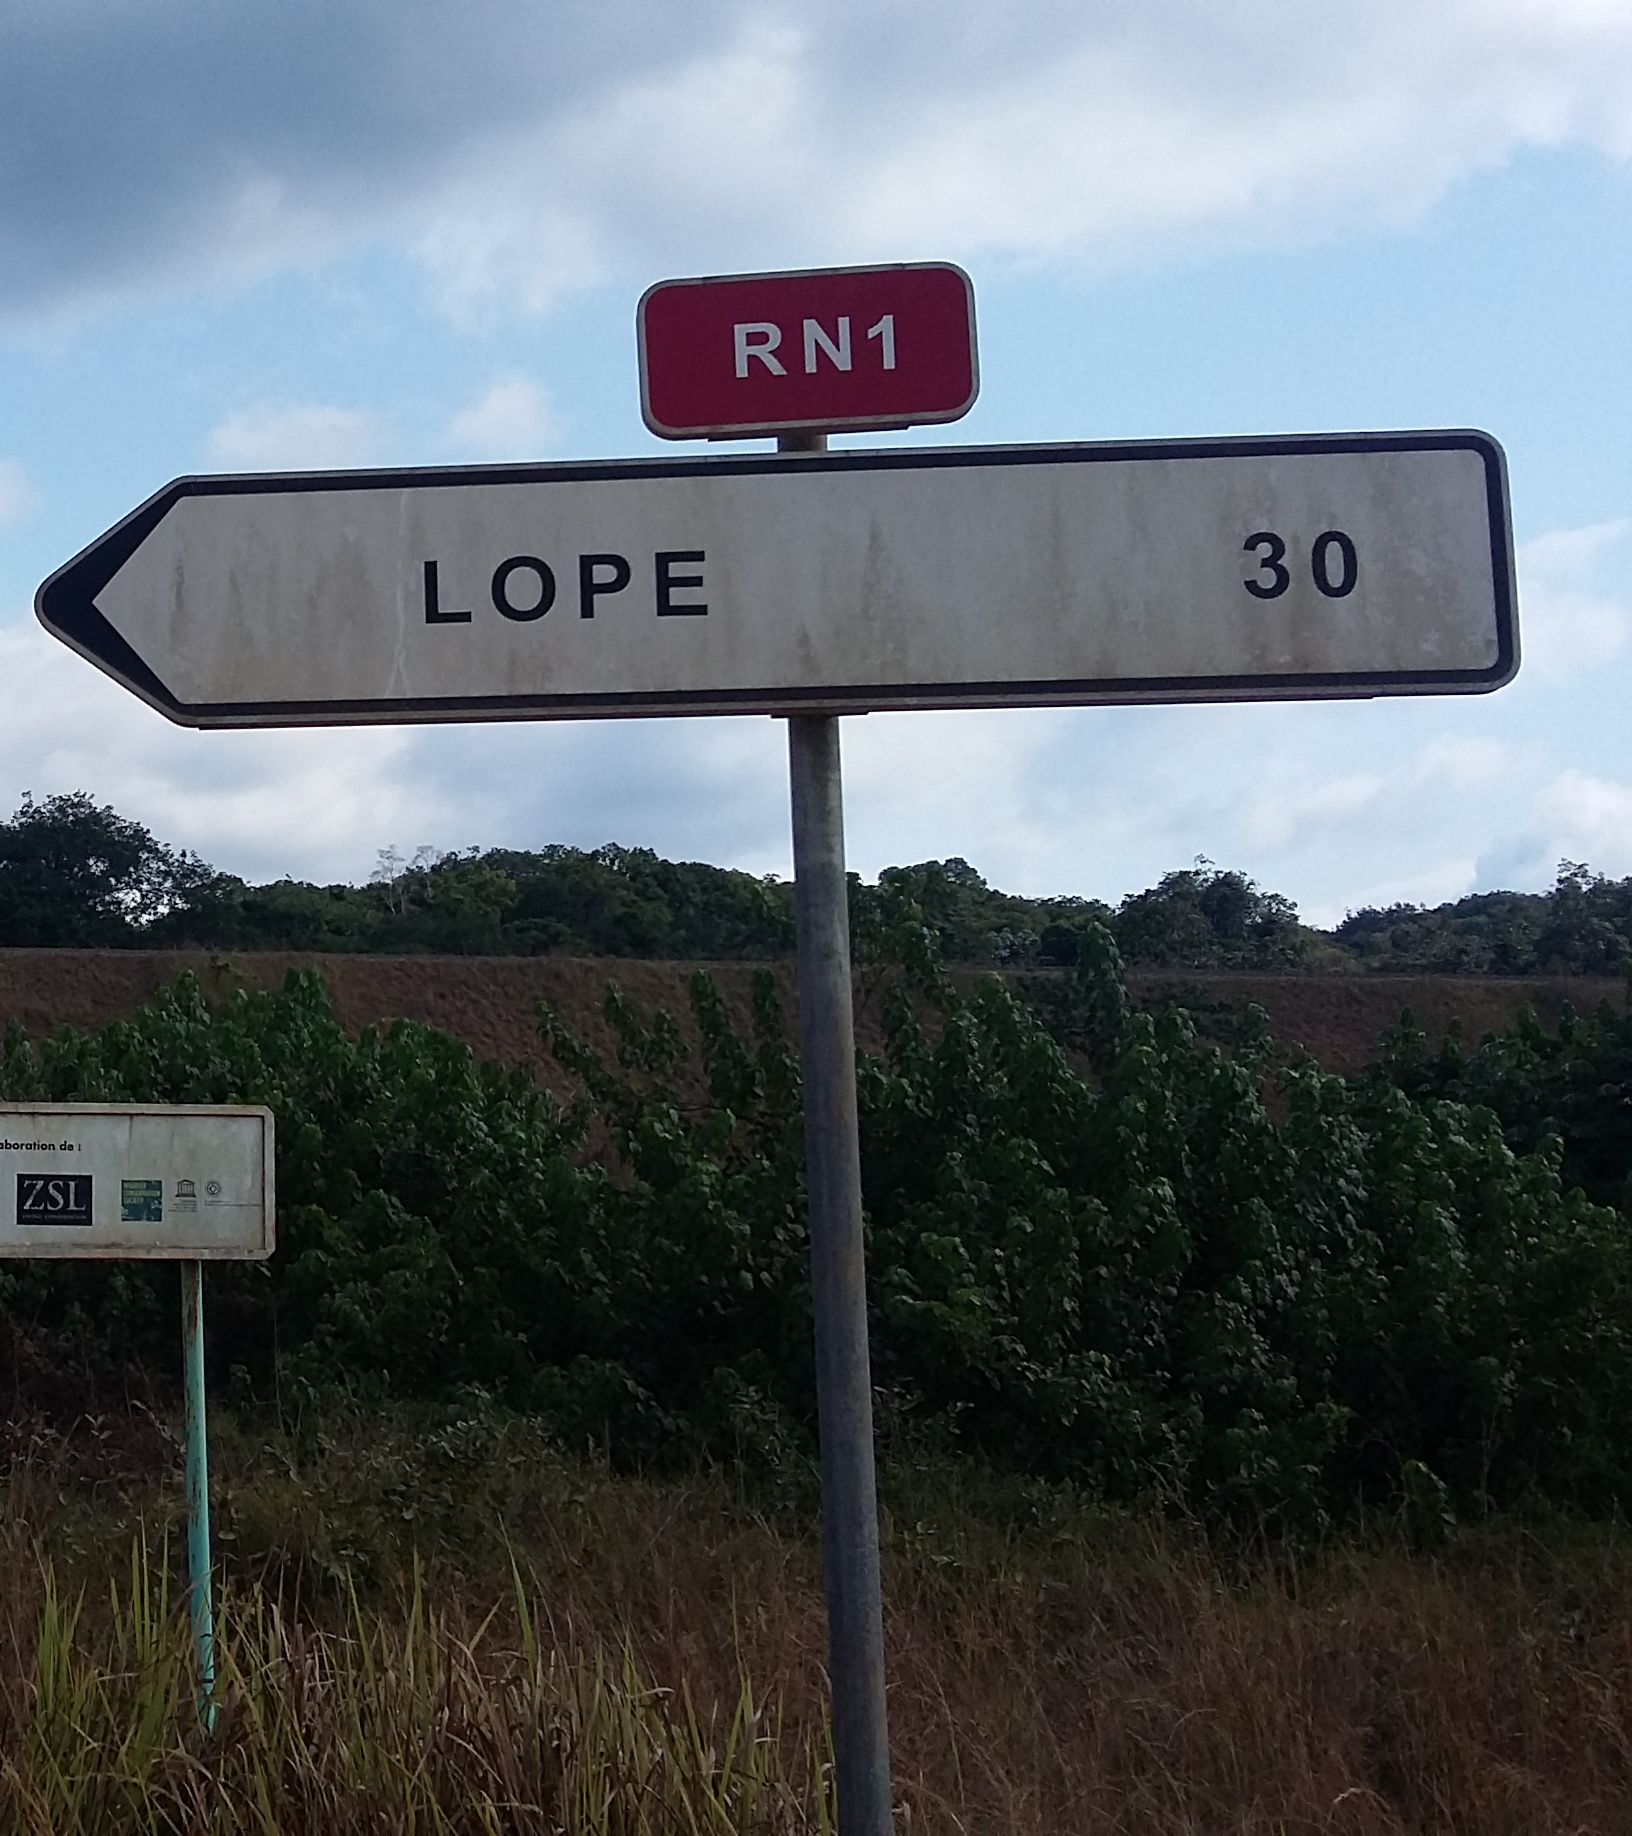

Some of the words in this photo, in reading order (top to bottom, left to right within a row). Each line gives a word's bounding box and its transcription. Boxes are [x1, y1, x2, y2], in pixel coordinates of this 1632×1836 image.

[733, 314, 897, 379] RN1
[423, 549, 710, 625] LOPE
[1242, 530, 1359, 601] 30
[59, 1140, 74, 1152] de
[23, 1179, 86, 1211] ZSL
